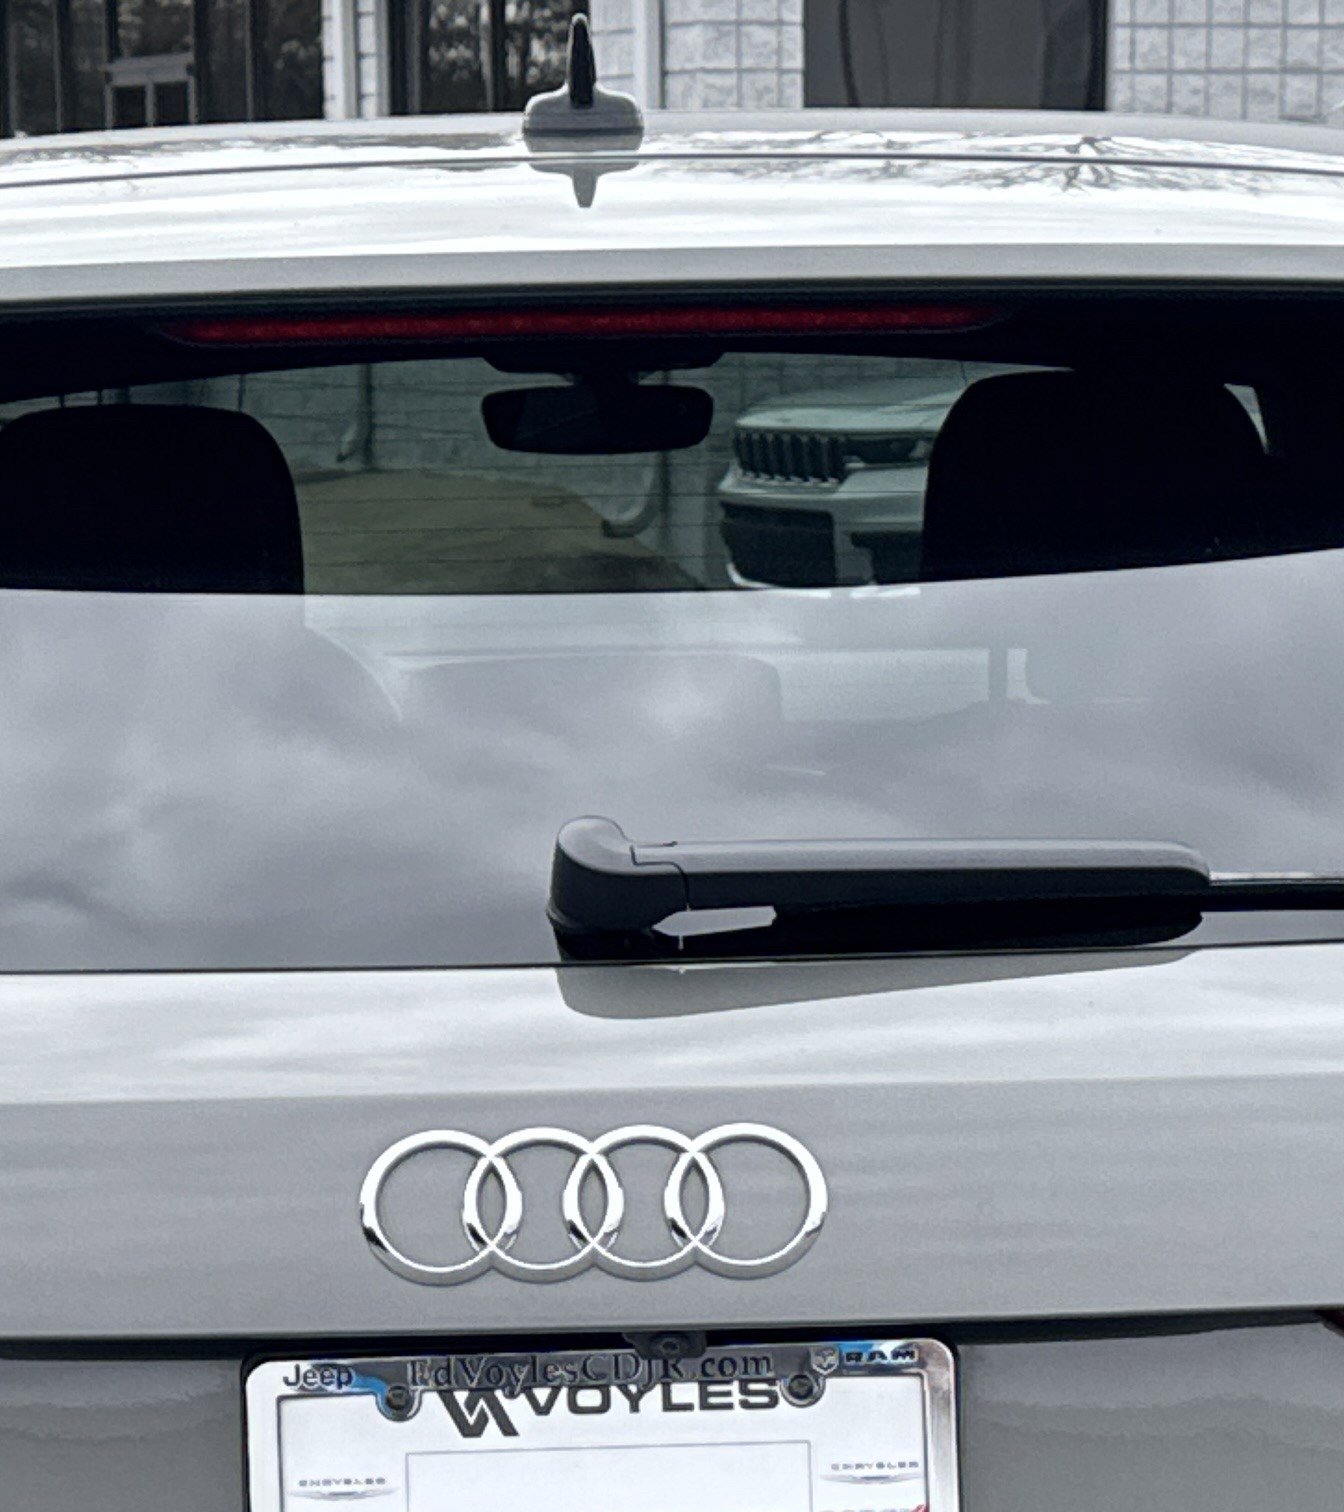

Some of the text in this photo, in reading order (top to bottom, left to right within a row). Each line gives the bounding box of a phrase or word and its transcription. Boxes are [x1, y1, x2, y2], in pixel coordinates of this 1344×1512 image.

[845, 1349, 916, 1364] RAM
[283, 1364, 353, 1391] Jeep
[523, 1377, 780, 1417] VOYLES
